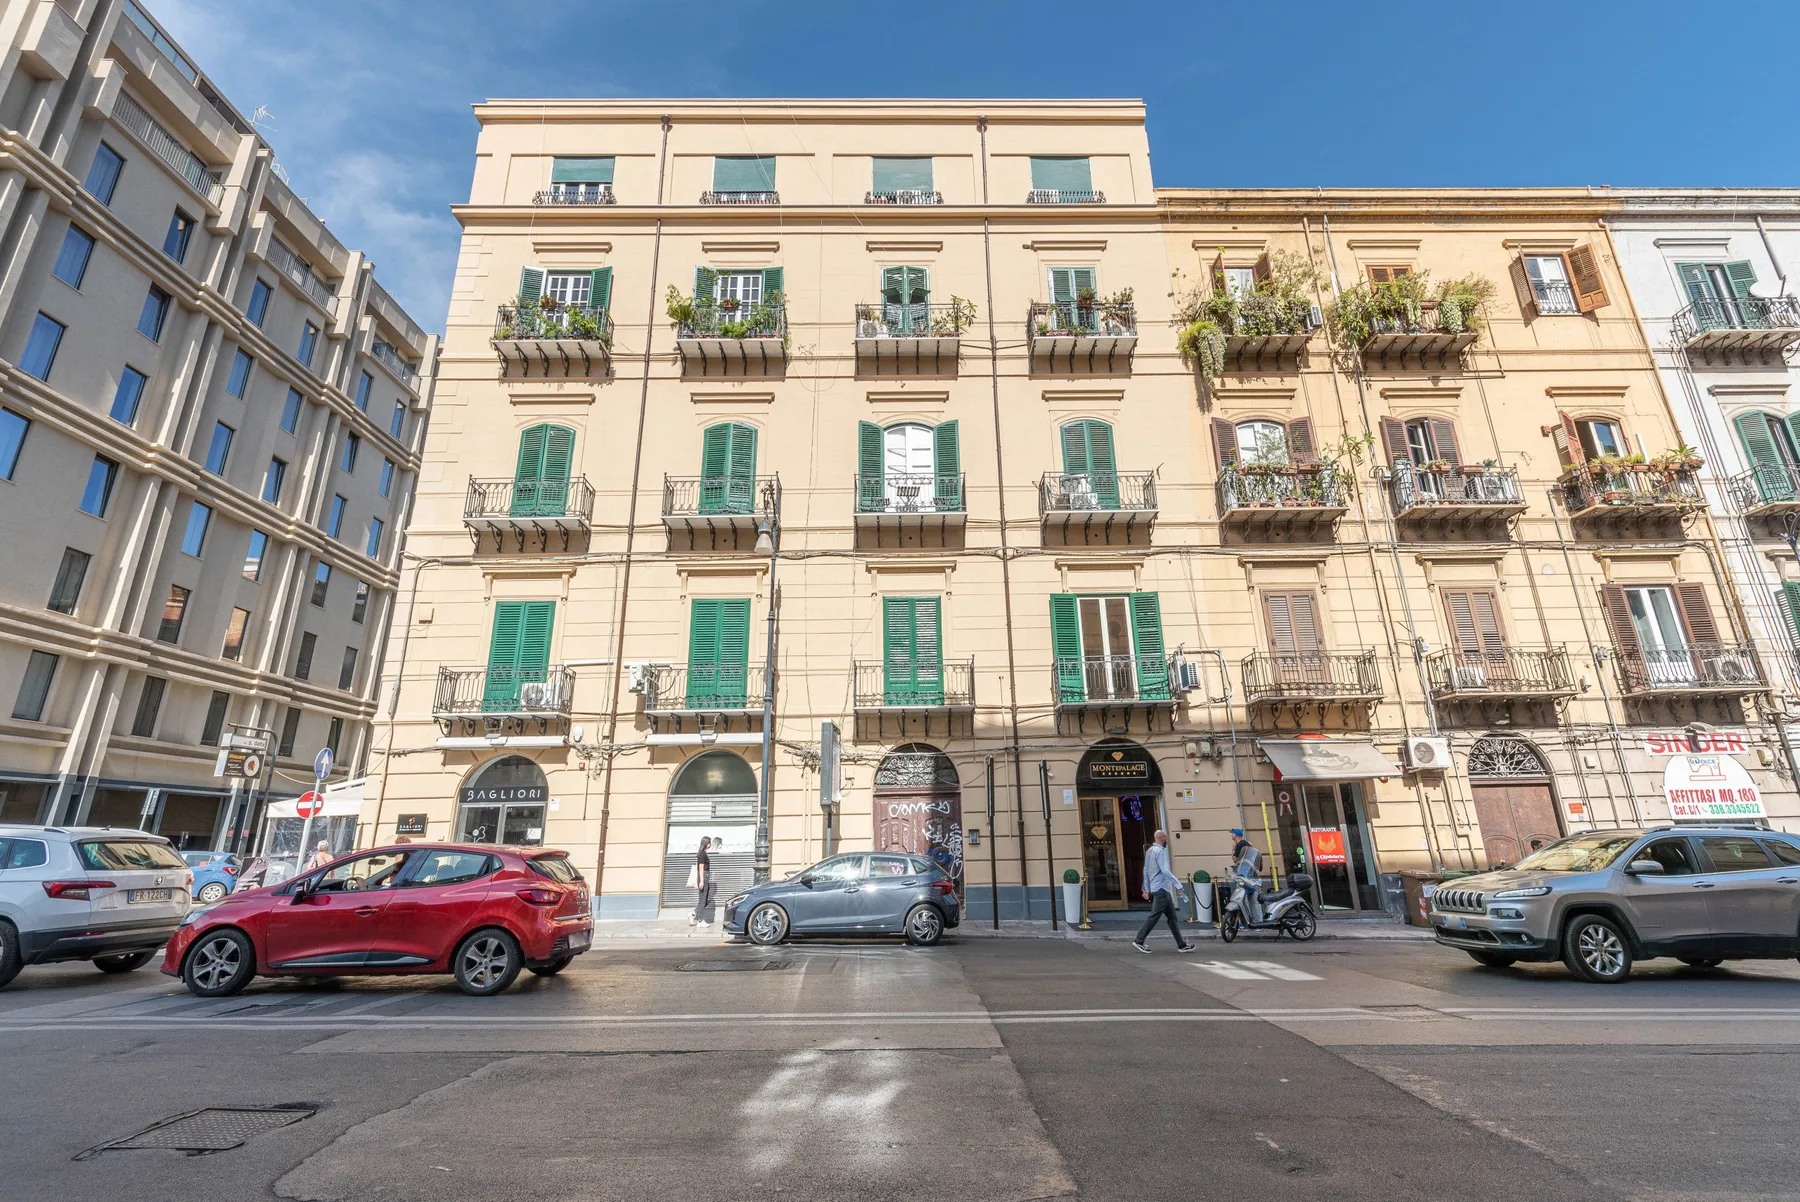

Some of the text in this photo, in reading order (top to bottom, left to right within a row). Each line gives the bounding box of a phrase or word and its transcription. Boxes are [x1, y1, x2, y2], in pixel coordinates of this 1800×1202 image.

[1647, 732, 1746, 753] SINGER
[467, 789, 541, 801] BAGLIORI
[1669, 789, 1717, 804] AFFITTASI
